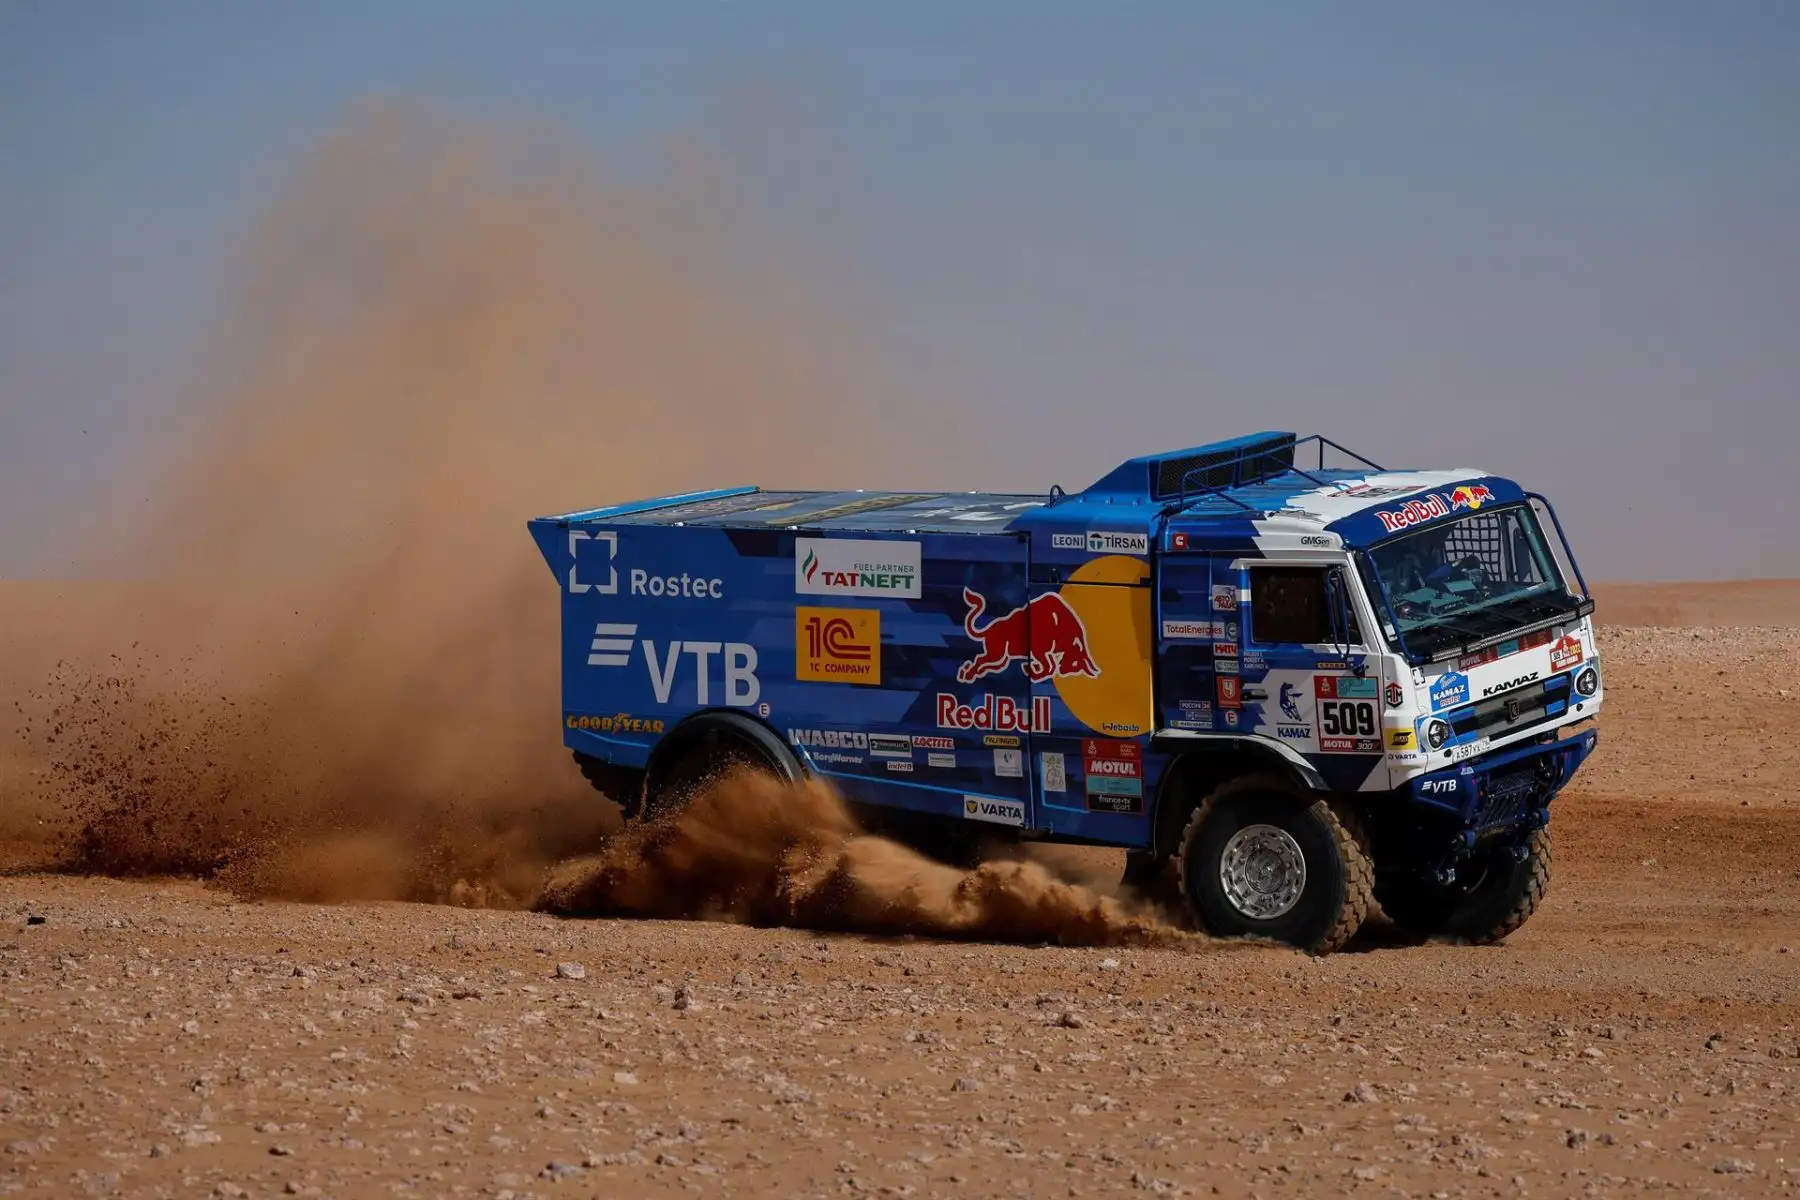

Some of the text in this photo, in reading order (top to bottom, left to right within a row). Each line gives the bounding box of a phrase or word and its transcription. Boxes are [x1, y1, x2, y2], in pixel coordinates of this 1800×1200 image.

[1375, 493, 1449, 533] Red Bull
[1053, 536, 1083, 546] LEONI
[853, 563, 914, 573] FUEL PARTNER
[631, 569, 723, 599] Rostec
[821, 572, 914, 589] TATNEFT
[642, 639, 760, 707] VTB
[810, 662, 870, 674] 1C COMPANY
[1483, 672, 1538, 697] KAMAZ
[1433, 685, 1466, 701] KAMAZ
[936, 693, 1051, 734] Red Bull
[1323, 702, 1375, 735] 509
[567, 714, 665, 734] GOODYEAR
[787, 728, 868, 749] WABCO
[1278, 727, 1312, 738] KAMAZ
[914, 737, 953, 748] LOCTITE
[1323, 740, 1353, 748] MOTUL
[813, 752, 864, 764] BorgWarner
[1090, 760, 1136, 775] MOTUL
[1432, 779, 1457, 794] VTB
[981, 803, 1022, 819] VARTA
